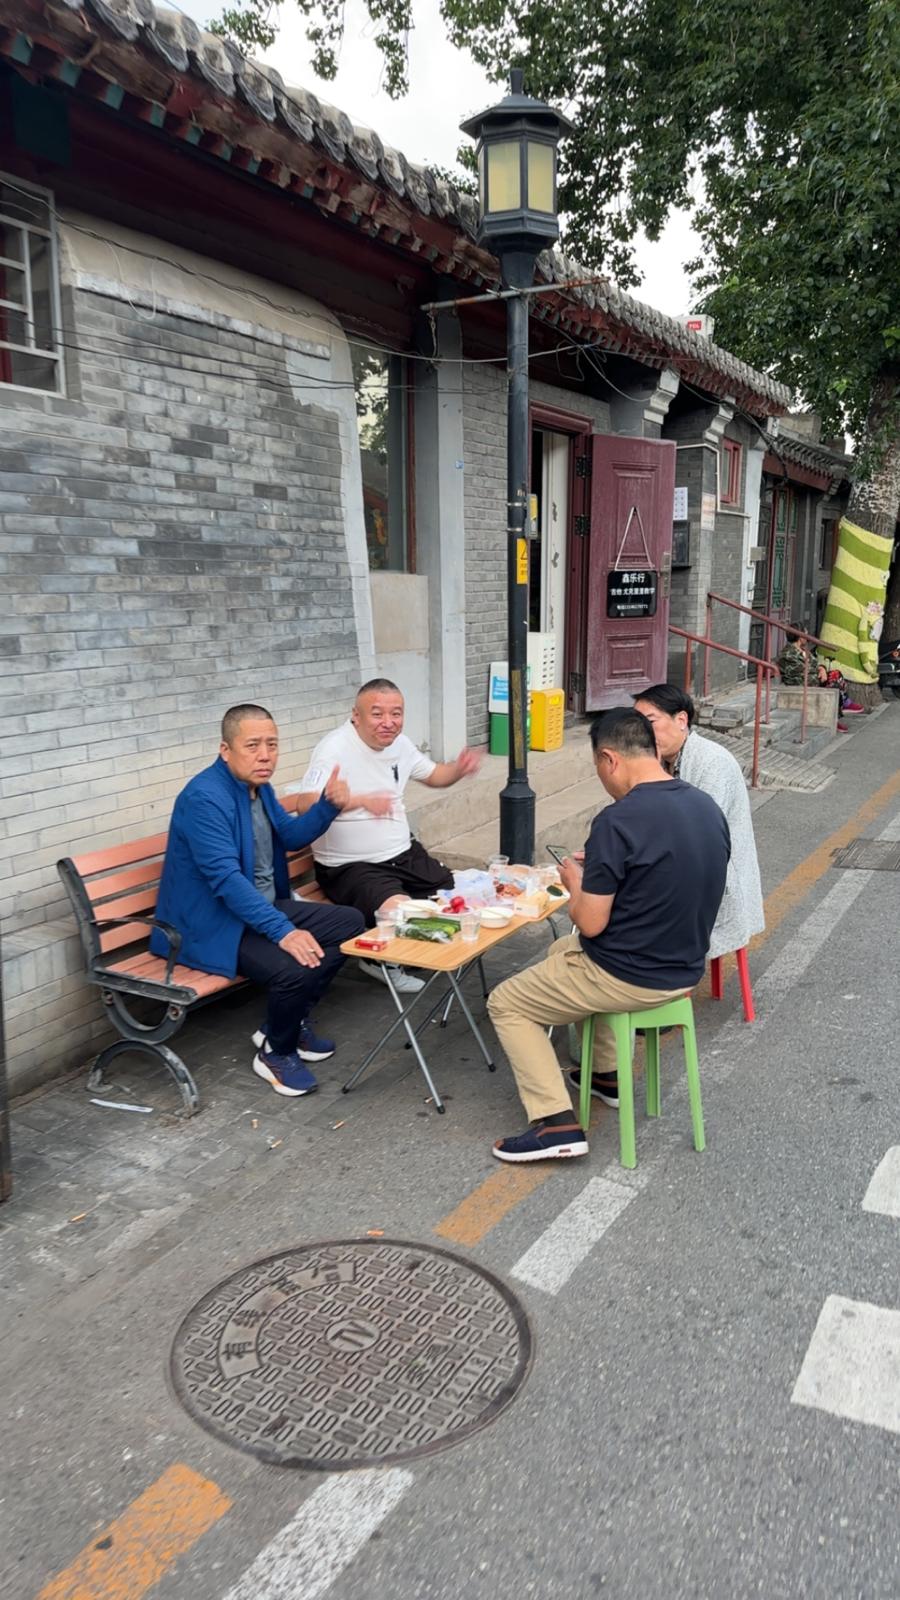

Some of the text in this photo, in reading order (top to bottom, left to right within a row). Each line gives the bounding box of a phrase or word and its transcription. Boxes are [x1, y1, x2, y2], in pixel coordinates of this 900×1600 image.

[622, 573, 645, 583] 鑫乐行
[611, 588, 622, 596] 吉他
[330, 1321, 375, 1347] TV
[445, 1356, 488, 1400] 2013
